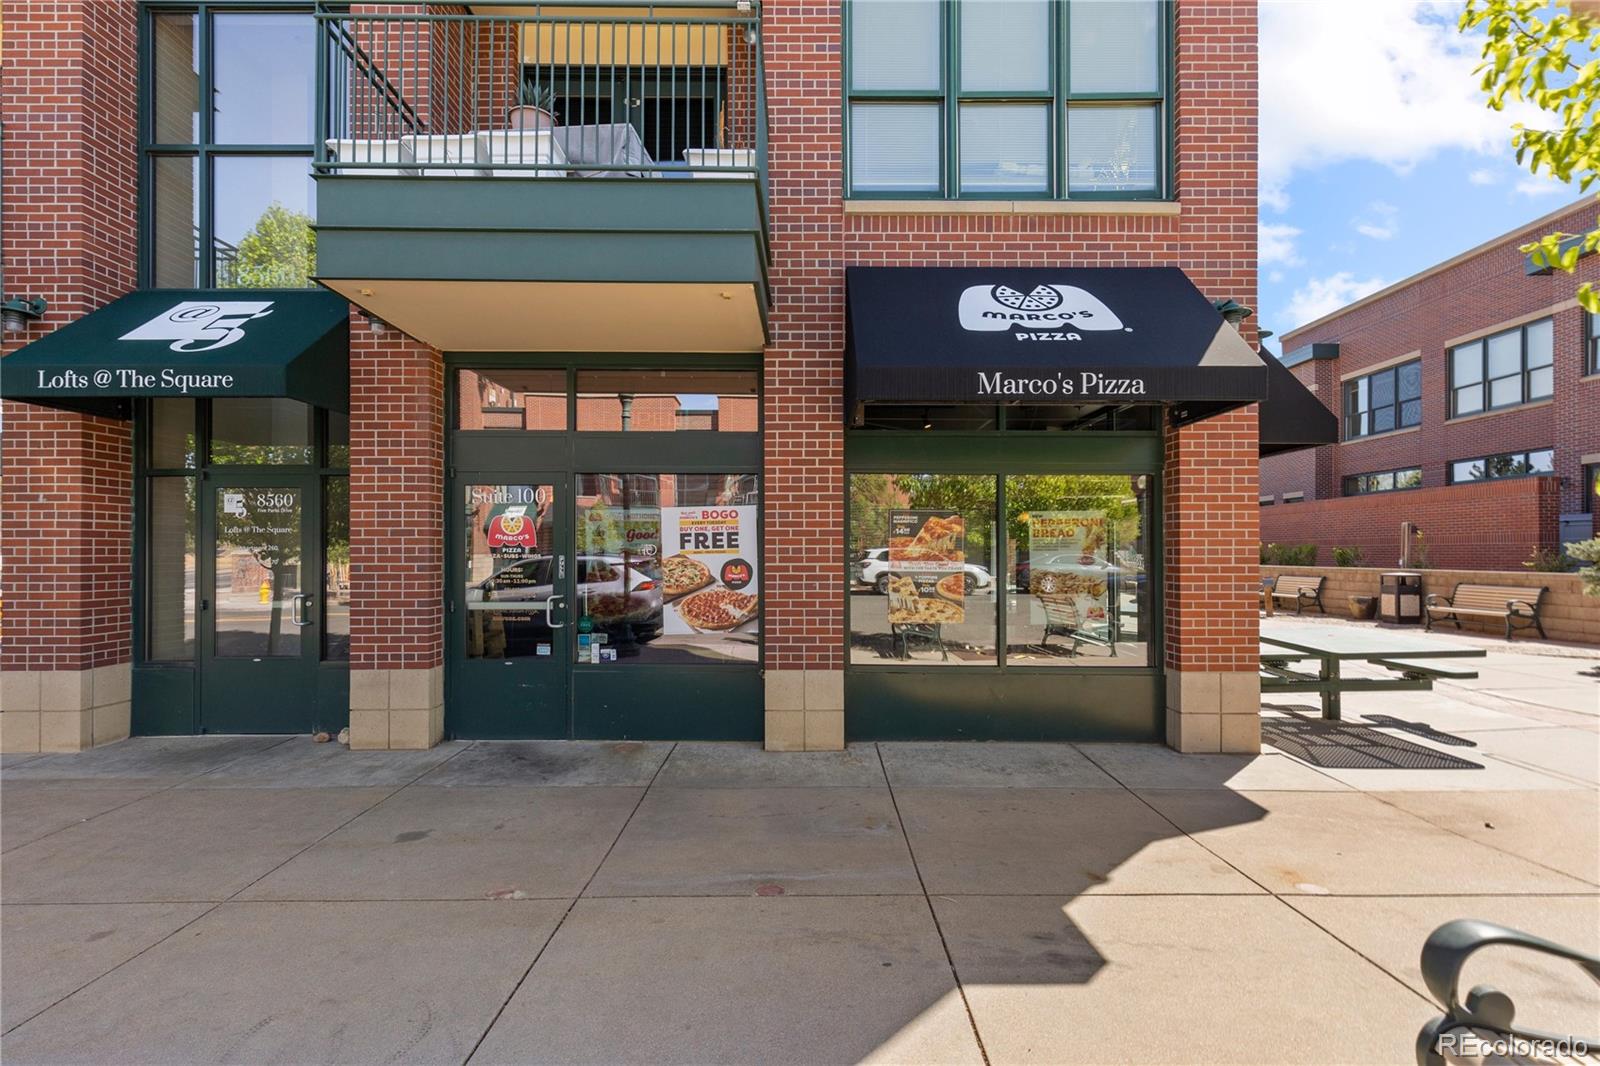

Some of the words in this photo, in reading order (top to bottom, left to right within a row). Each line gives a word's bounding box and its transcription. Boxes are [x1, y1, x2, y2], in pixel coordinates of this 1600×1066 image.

[982, 311, 1094, 321] MARCO'S
[1015, 332, 1082, 341] PIZZA
[37, 370, 88, 389] Lofts
[93, 369, 112, 388] @
[116, 370, 156, 388] The
[161, 369, 234, 393] Square
[977, 372, 1074, 395] Marco's
[1080, 372, 1146, 395] Pizza
[257, 494, 293, 507] 8560
[471, 488, 513, 504] Suite
[518, 488, 546, 504] 100
[701, 510, 739, 519] BOGO
[495, 533, 530, 541] MARCO'S
[680, 532, 740, 550] FREE
